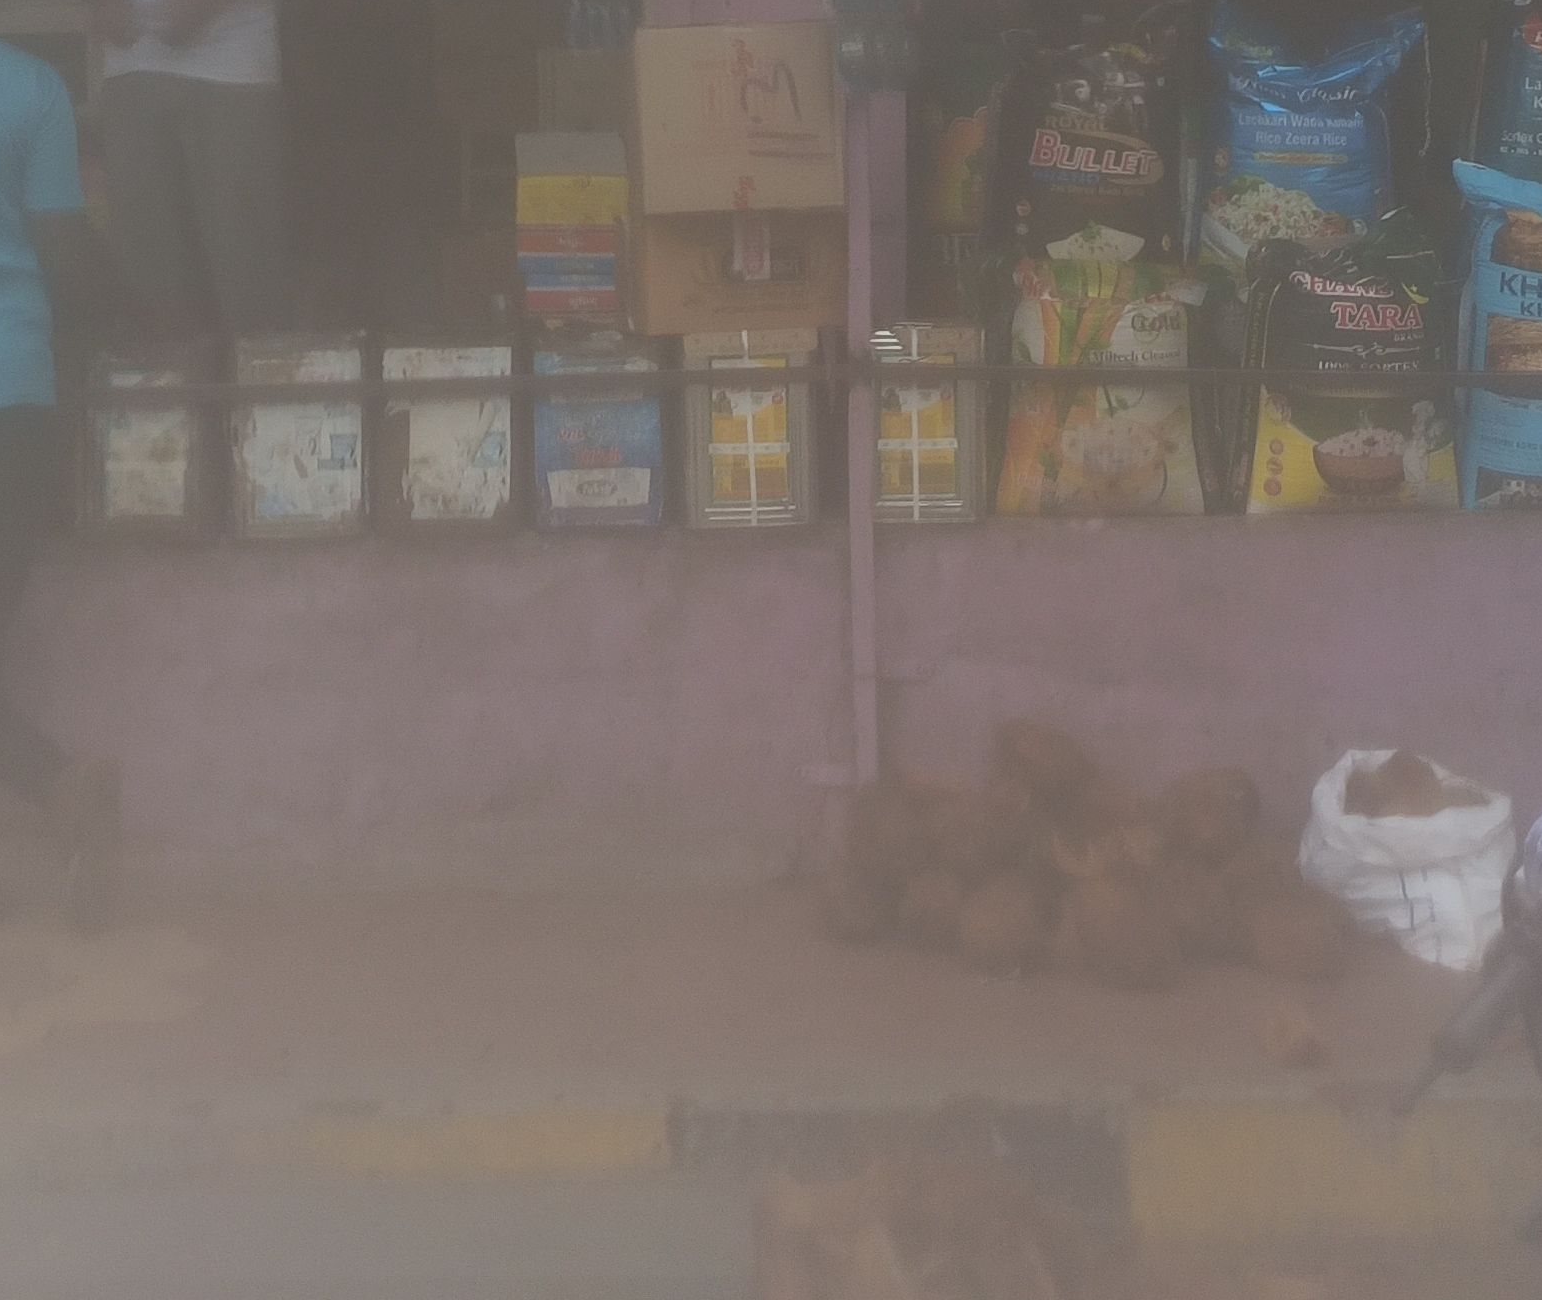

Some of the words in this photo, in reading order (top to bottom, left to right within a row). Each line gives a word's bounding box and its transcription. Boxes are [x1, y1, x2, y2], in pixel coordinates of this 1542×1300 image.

[1044, 115, 1109, 132] ROYAL
[1322, 132, 1348, 147] Rice
[1029, 128, 1159, 176] BULLET
[1330, 301, 1424, 331] TARA
